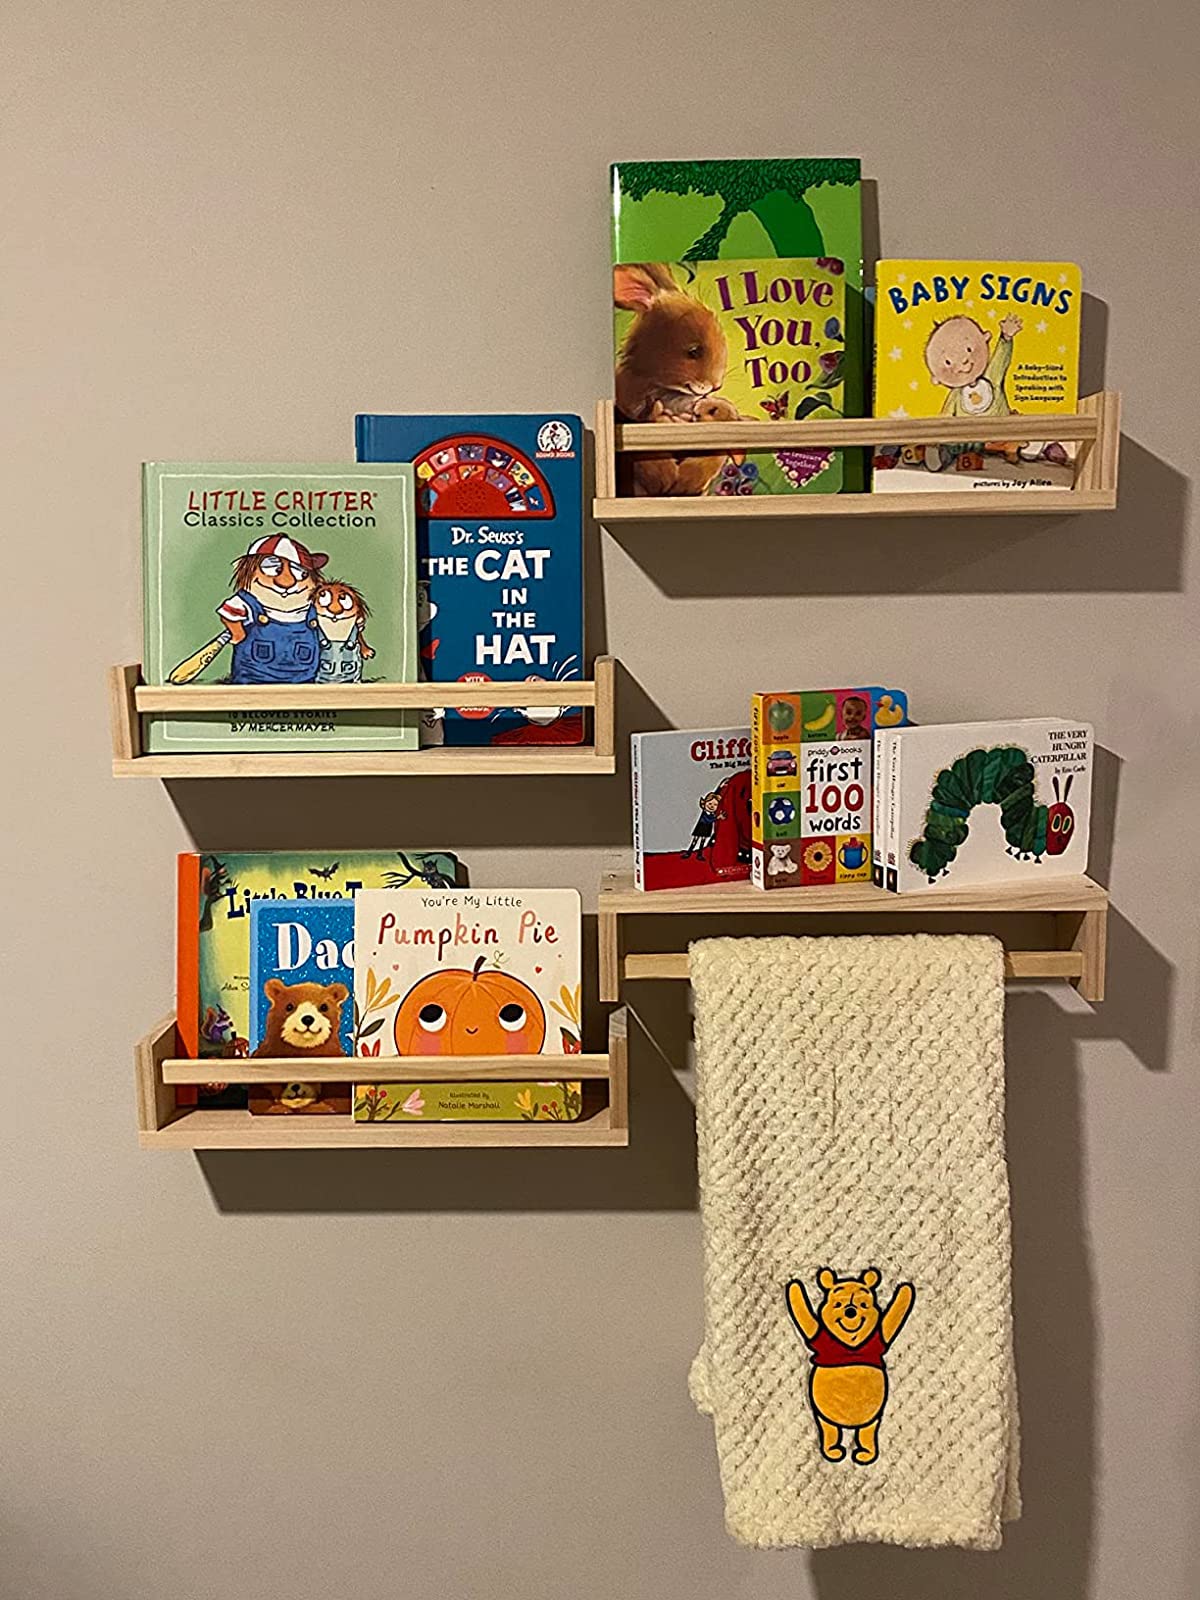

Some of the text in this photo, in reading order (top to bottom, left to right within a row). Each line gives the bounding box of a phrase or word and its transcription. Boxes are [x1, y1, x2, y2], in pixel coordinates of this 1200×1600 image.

[714, 275, 735, 312] I
[739, 270, 834, 308] Love
[887, 276, 970, 314] BABY
[980, 273, 1073, 315] SIGNS
[733, 315, 821, 351] You,
[744, 356, 812, 389] Too
[1015, 384, 1047, 393] Speaking
[1014, 394, 1065, 403] Sign Language
[973, 478, 1052, 489] pictures by Joy Allen
[188, 490, 267, 511] LITTLE
[183, 511, 376, 528] Classics Collection
[450, 526, 524, 545] Dr. Seuss's
[422, 549, 551, 582] THE CAT
[502, 587, 528, 605] IN
[491, 611, 536, 628] THE
[475, 634, 556, 665] HAT
[241, 711, 290, 719] BELOVED
[293, 711, 337, 719] STORIES
[230, 722, 336, 733] BY MERCER MAYER
[1048, 729, 1088, 740] THE VERY
[807, 749, 829, 757] priddy
[1052, 741, 1088, 751] HUNGRY
[724, 761, 736, 769] Big
[1030, 752, 1087, 764] CATERPILLAR
[806, 757, 863, 783] first
[805, 783, 864, 814] 100
[809, 812, 861, 833] words
[421, 895, 523, 908] You're My Little
[377, 910, 559, 961] Pumpkin Pie
[438, 1101, 501, 1109] Natalie Marshall
